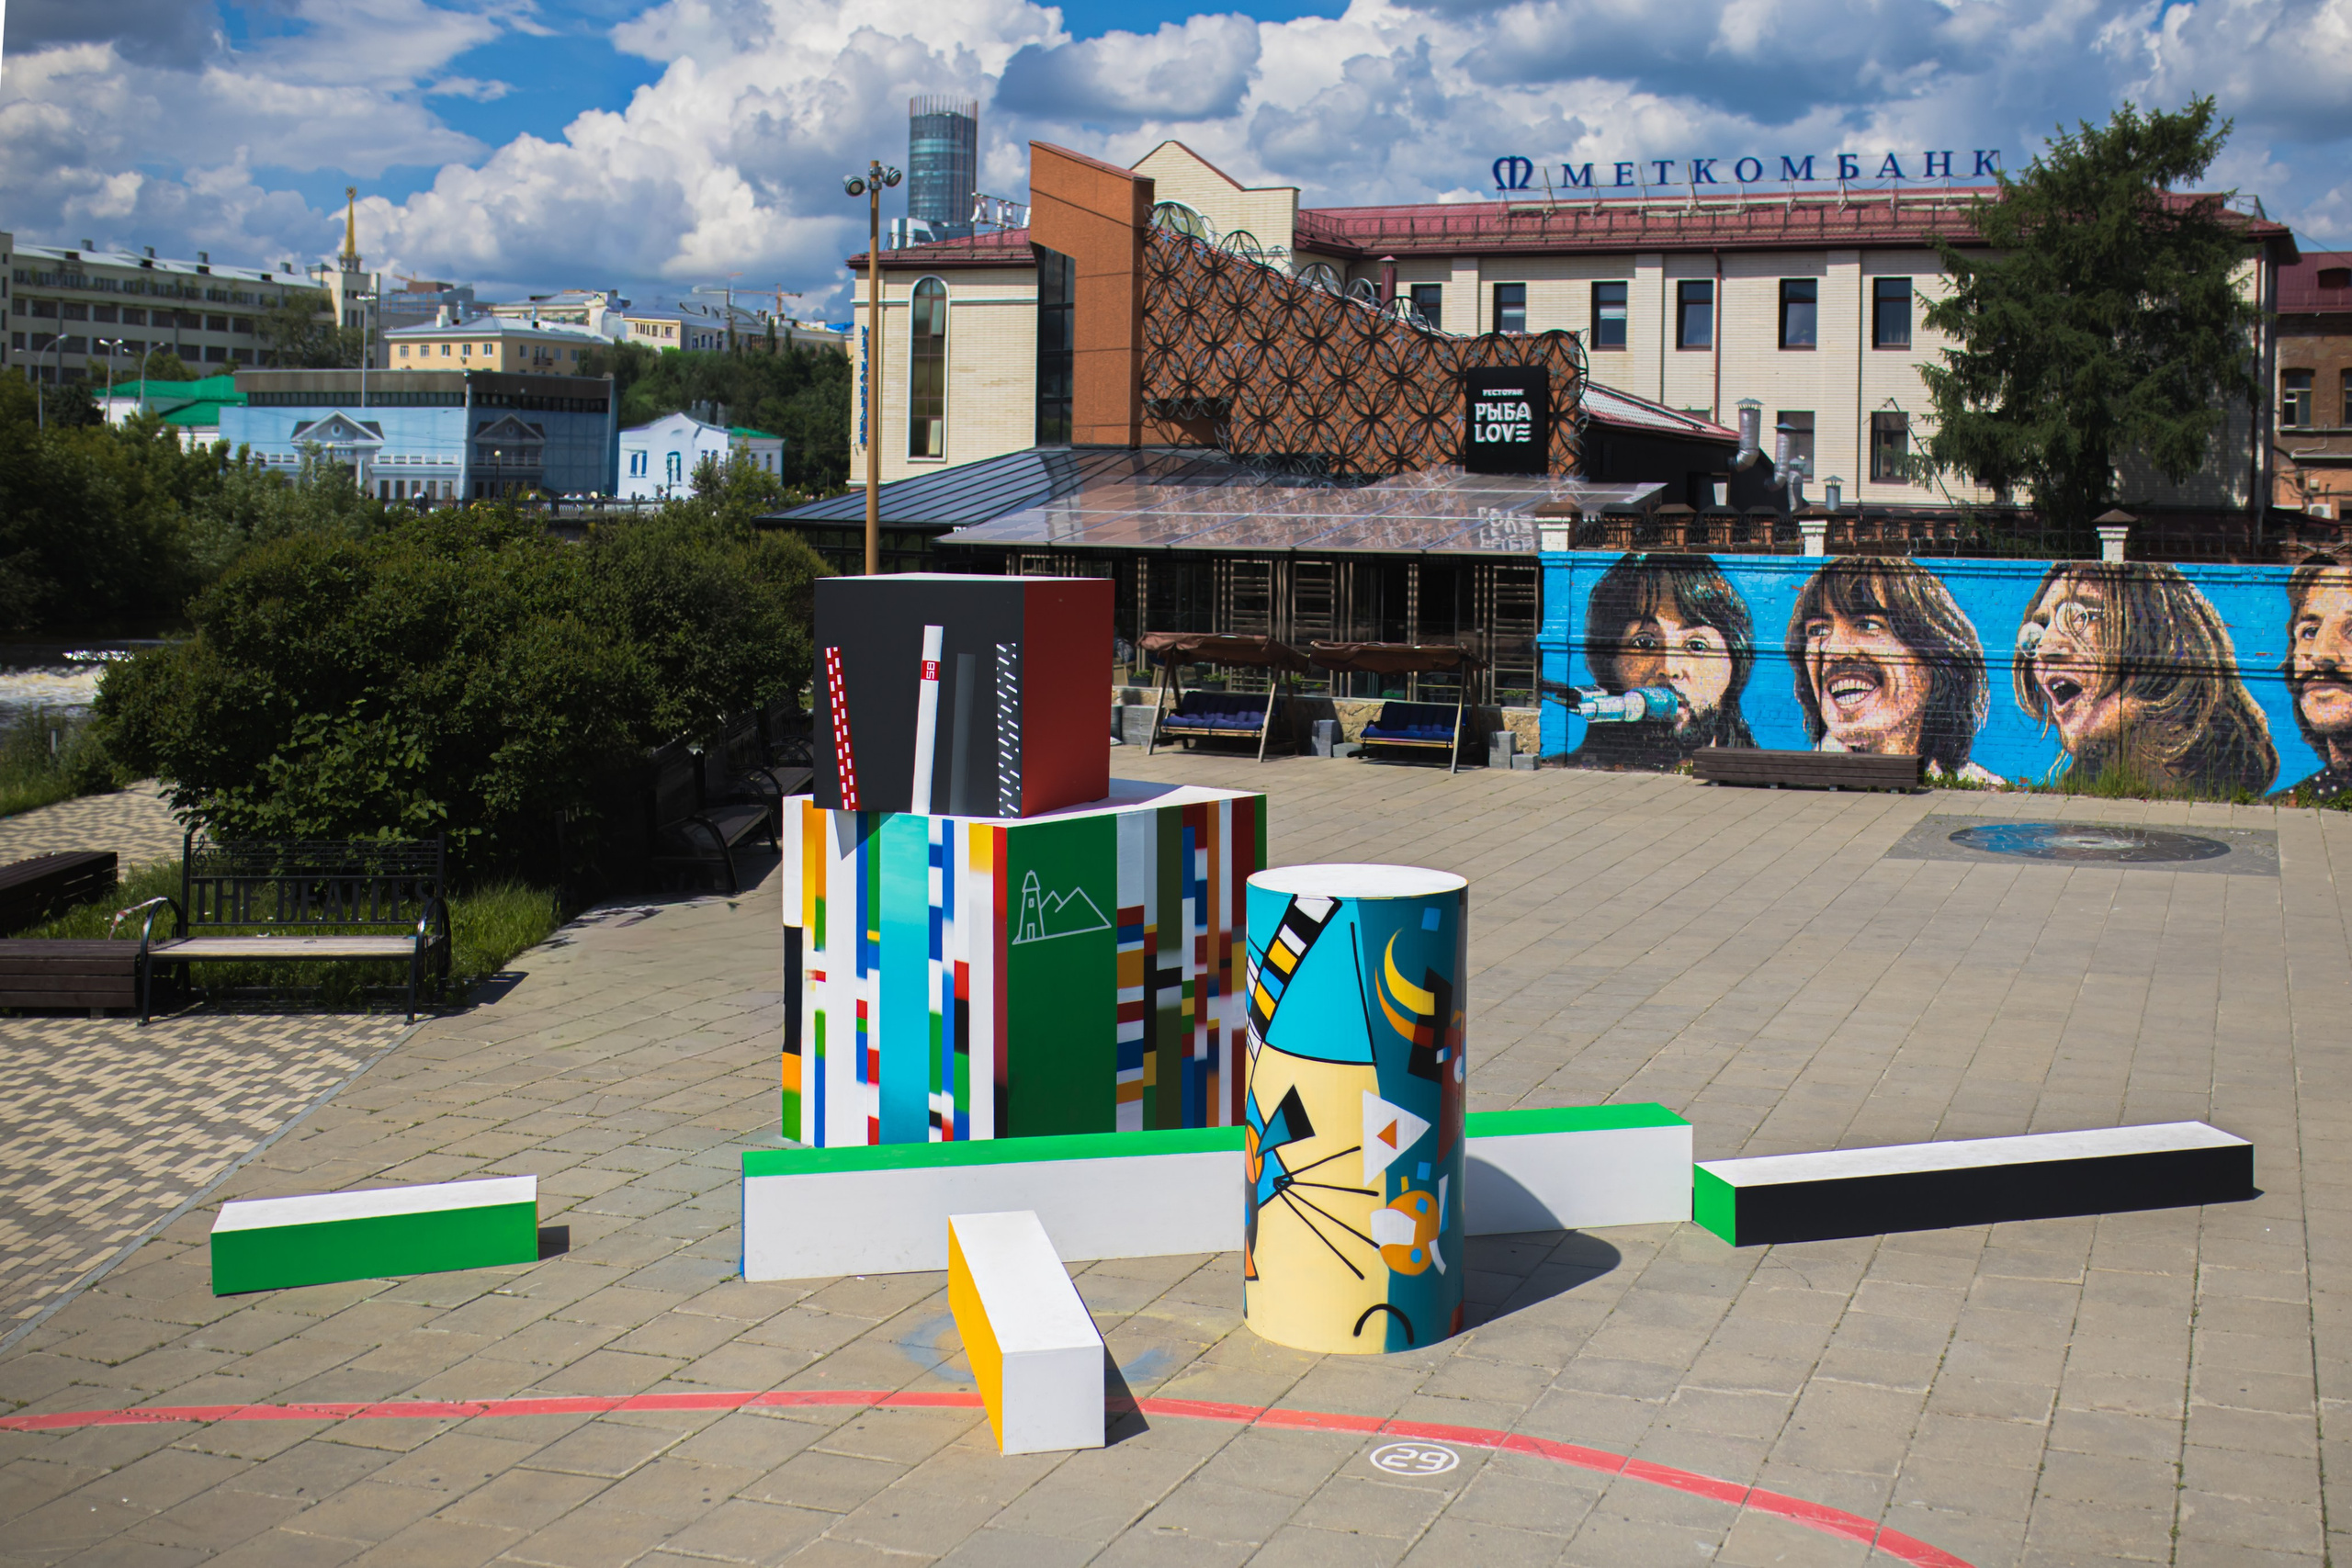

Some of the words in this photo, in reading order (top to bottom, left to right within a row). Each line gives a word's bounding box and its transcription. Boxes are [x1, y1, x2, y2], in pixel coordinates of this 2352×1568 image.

[1563, 151, 2000, 188] МЕТКОМБАНК
[1475, 401, 1532, 421] РЫБА
[1475, 423, 1531, 443] LOVE
[192, 879, 261, 923] THE
[277, 879, 435, 923] BEATLES
[1381, 1448, 1449, 1470] 29
